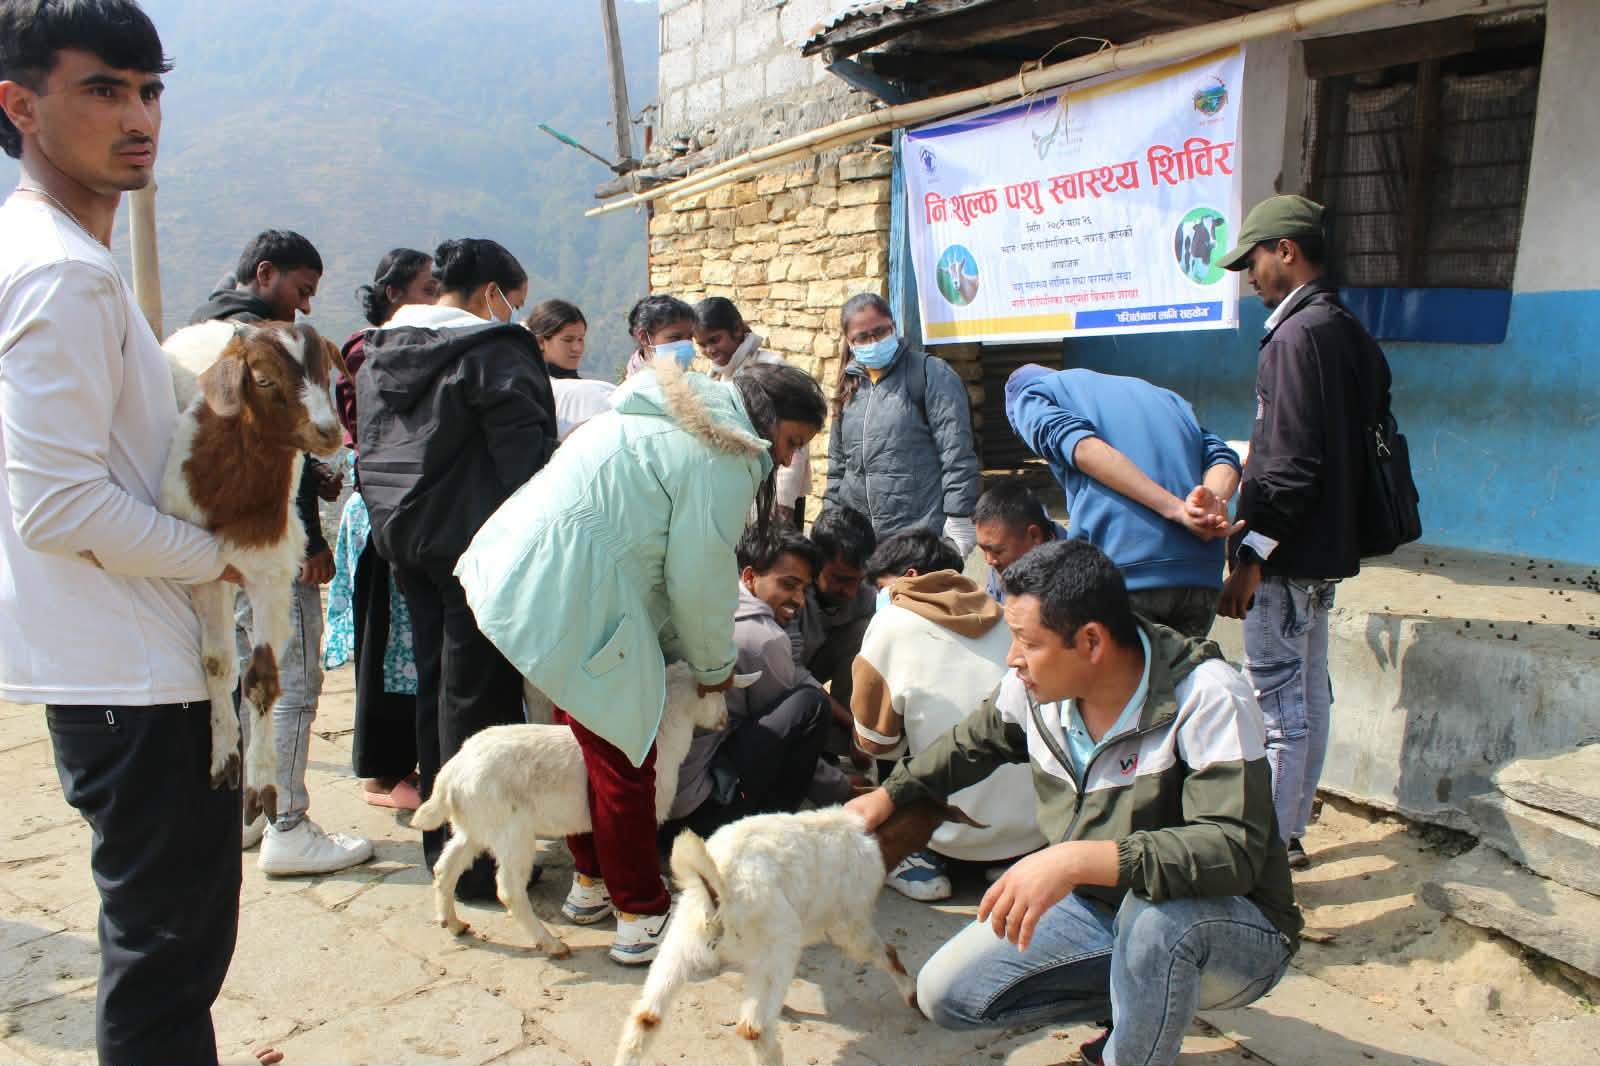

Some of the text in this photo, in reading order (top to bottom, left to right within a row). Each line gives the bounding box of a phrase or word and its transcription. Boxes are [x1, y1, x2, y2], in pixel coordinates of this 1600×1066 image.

[1005, 181, 1044, 214] पशु
[1048, 160, 1139, 204] स्वास्थ्य
[1147, 137, 1234, 186] शिविर
